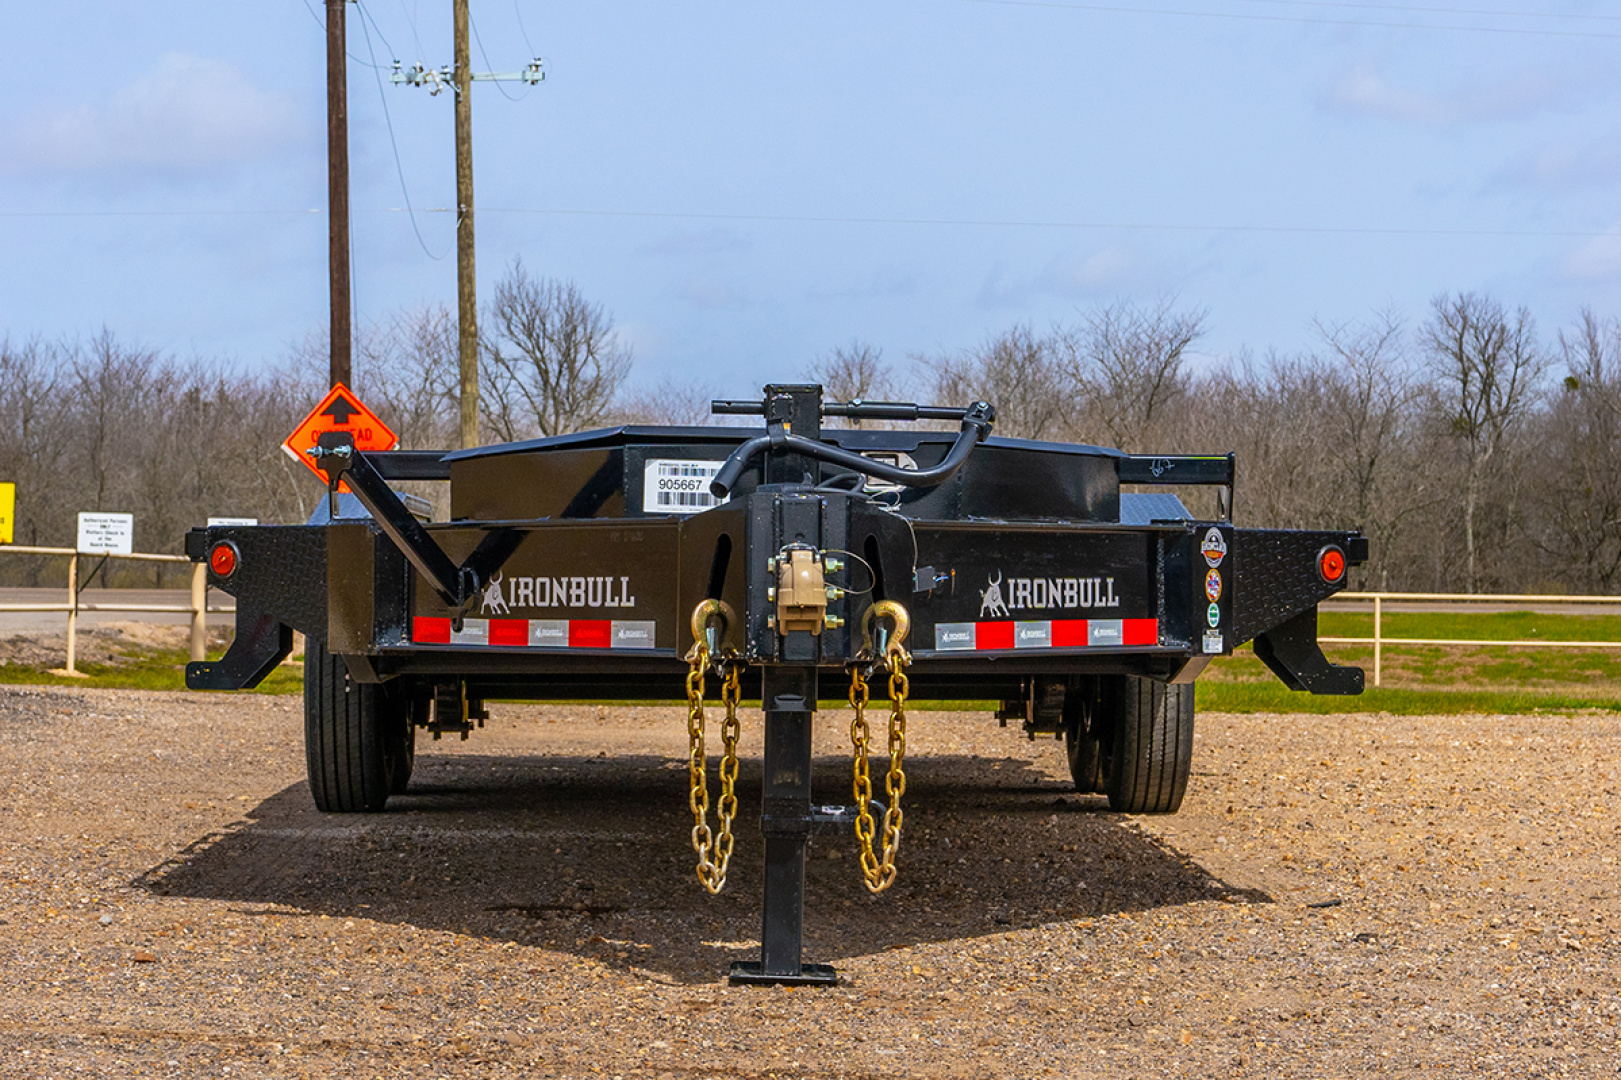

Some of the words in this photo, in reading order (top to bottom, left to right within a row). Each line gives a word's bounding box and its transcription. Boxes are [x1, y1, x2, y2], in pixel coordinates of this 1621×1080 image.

[658, 478, 703, 491] 905667
[509, 576, 635, 608] IRONBULL
[1007, 577, 1120, 609] IRONBULL
